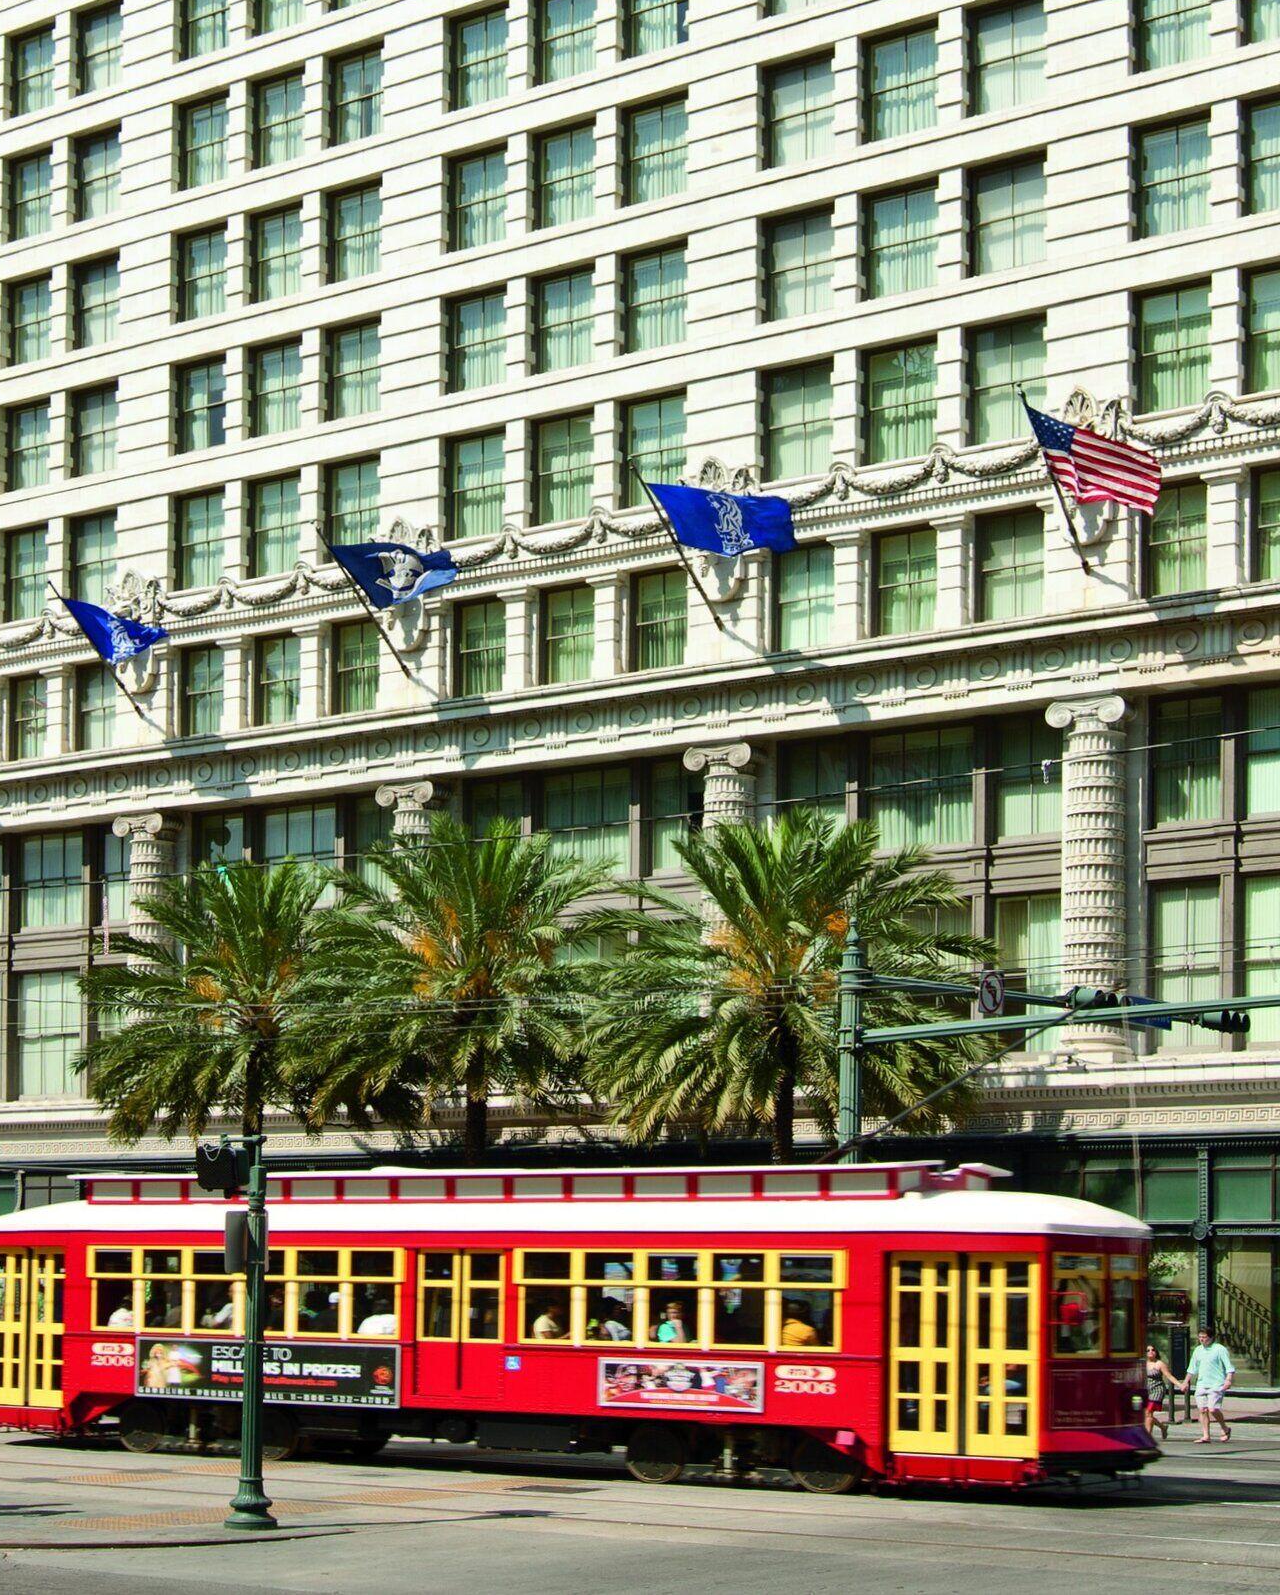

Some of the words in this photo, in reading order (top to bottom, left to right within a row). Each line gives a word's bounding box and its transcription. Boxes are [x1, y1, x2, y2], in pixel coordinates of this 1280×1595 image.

[91, 1355, 135, 1367] 2006
[269, 1347, 293, 1361] TO
[211, 1360, 281, 1375] MILLNS
[282, 1363, 300, 1375] IN
[302, 1363, 361, 1377] PRIZES!
[774, 1379, 836, 1394] 2006
[263, 1391, 284, 1400] ALL
